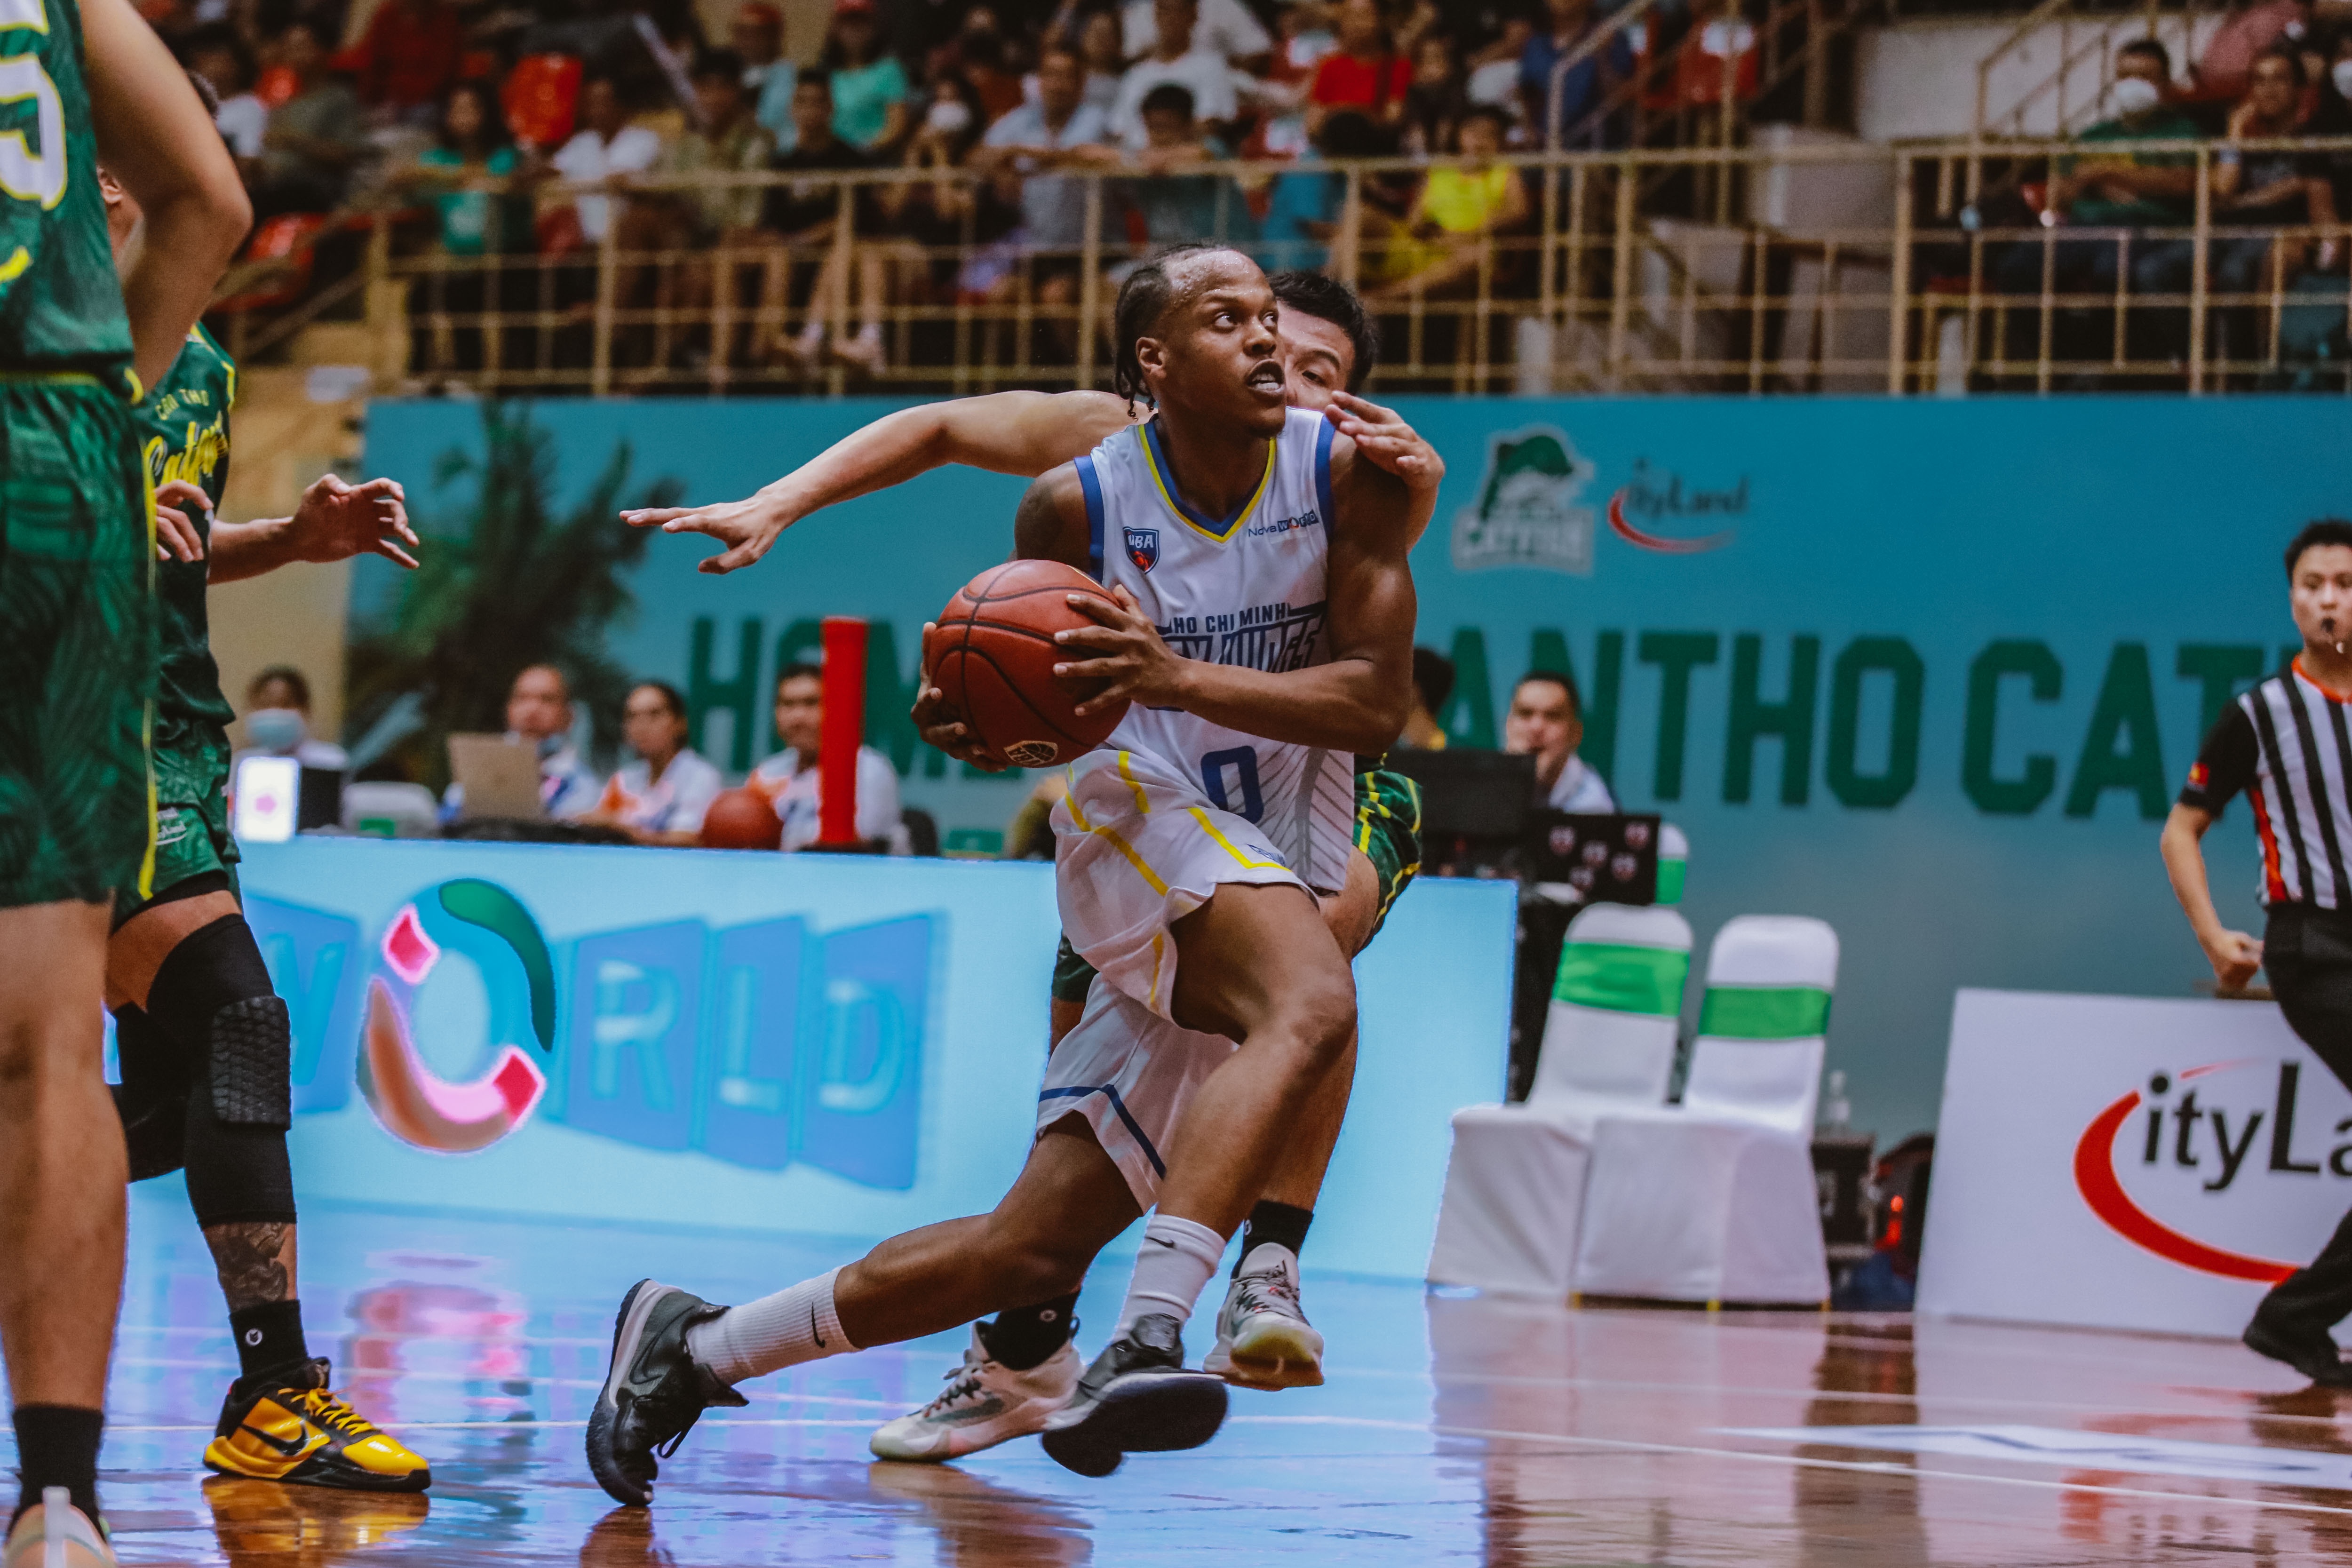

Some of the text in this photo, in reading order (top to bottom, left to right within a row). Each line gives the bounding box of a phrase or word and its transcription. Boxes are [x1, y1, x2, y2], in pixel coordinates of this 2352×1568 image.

[1173, 602, 1286, 634] HO CHI MINH
[1200, 745, 1263, 824] 0
